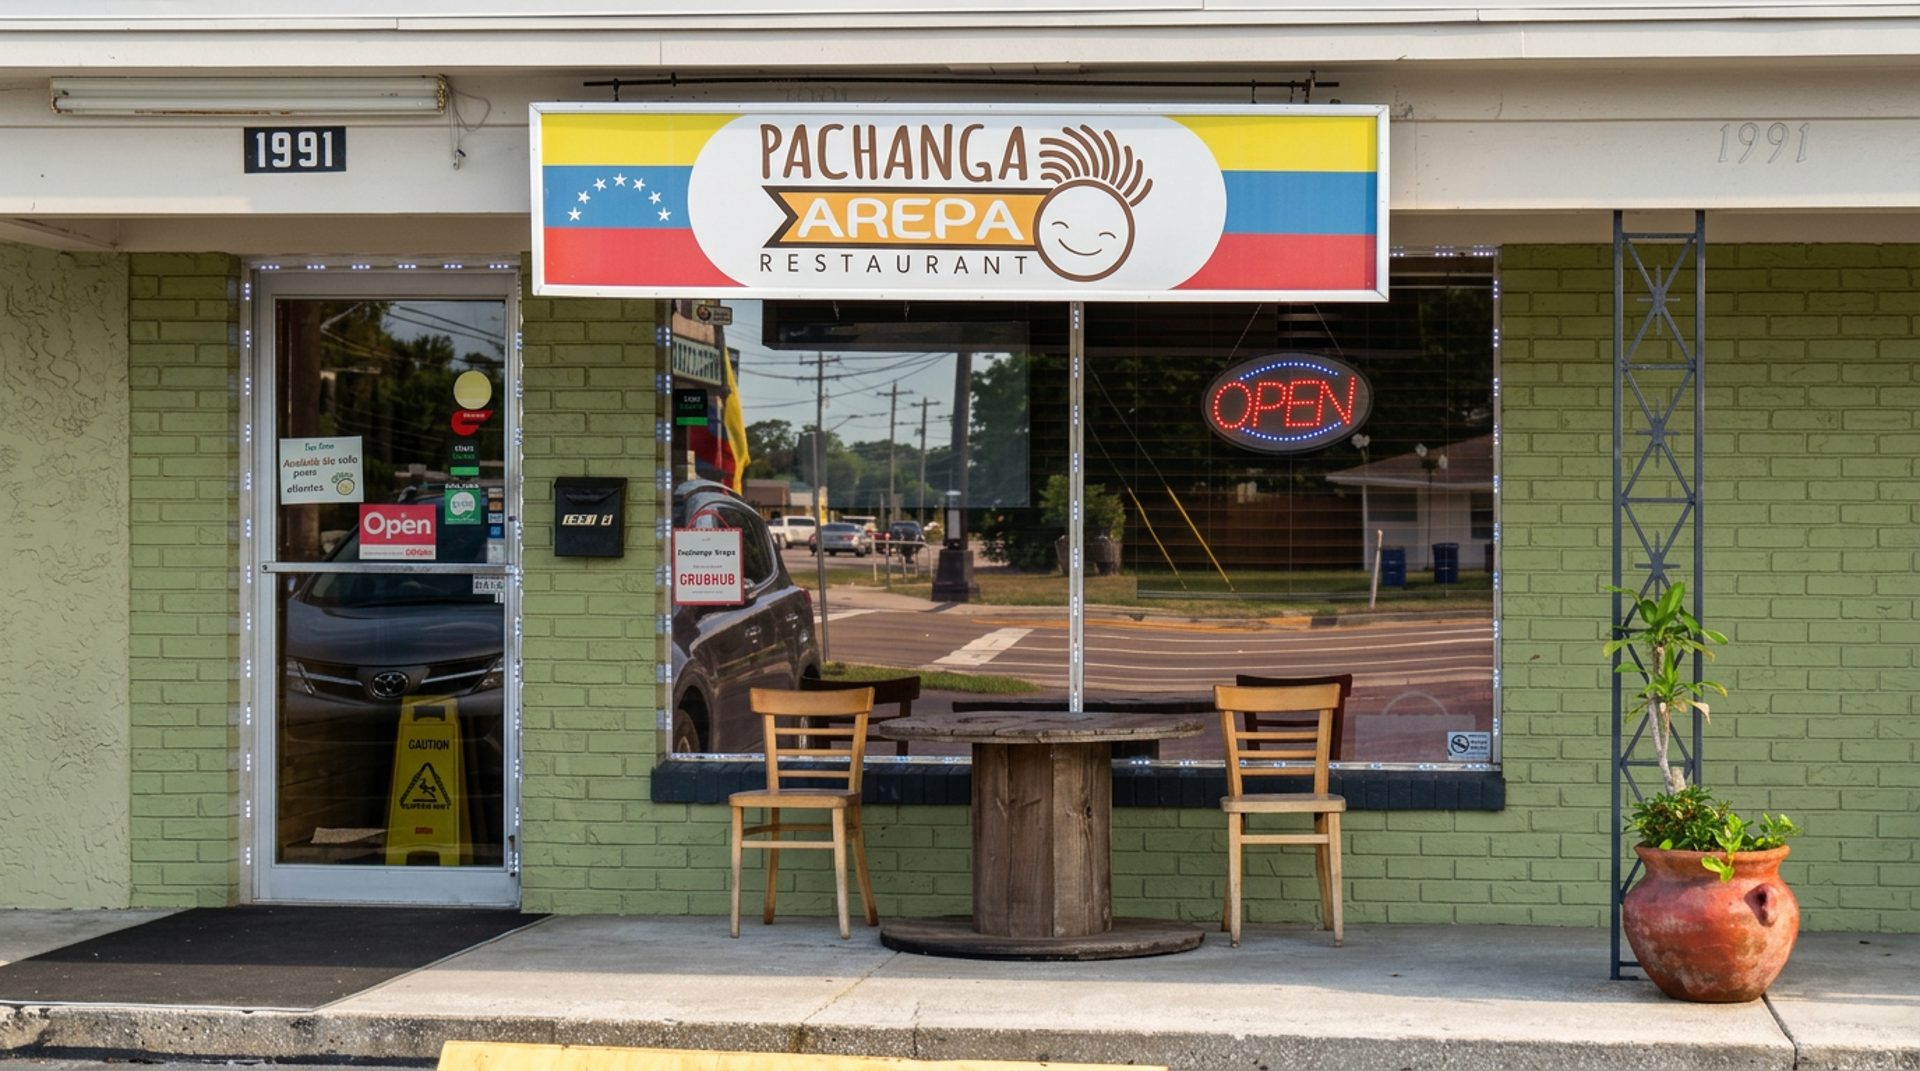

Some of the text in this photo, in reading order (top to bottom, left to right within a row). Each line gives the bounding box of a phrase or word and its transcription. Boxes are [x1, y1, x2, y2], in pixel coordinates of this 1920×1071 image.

[256, 131, 332, 168] 1991
[760, 123, 1028, 182] PACHANGA
[1717, 121, 1810, 164] 1991
[797, 197, 1024, 241] AREPA
[760, 253, 1028, 275] RESTAURANT
[1212, 375, 1357, 430] OPEN
[363, 511, 432, 540] Open
[680, 573, 736, 586] GRUBHUB
[408, 739, 449, 750] CAUTION
